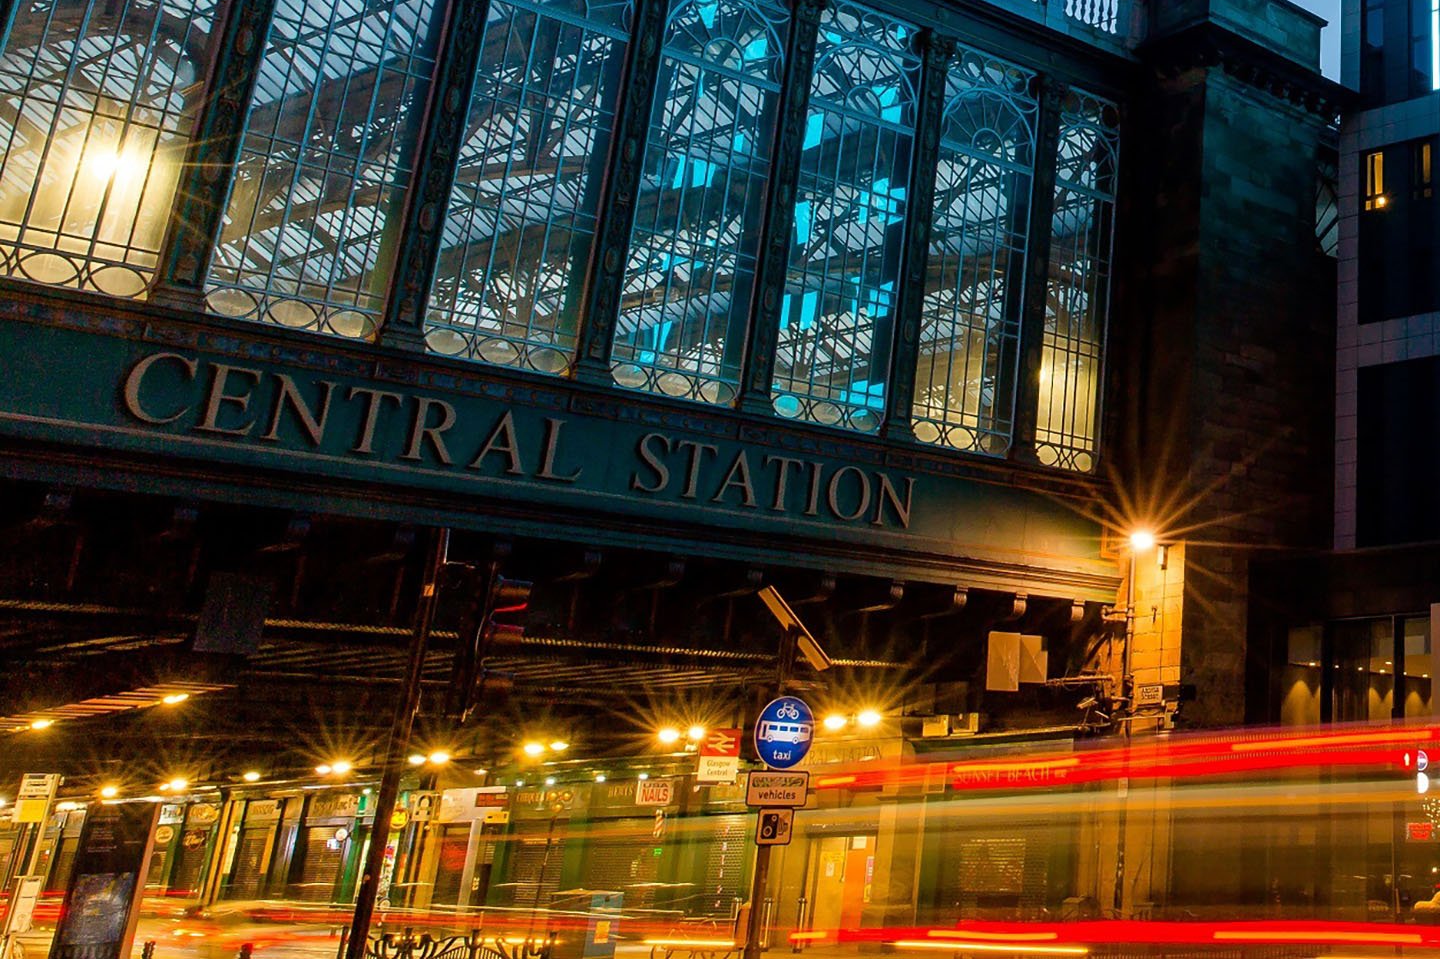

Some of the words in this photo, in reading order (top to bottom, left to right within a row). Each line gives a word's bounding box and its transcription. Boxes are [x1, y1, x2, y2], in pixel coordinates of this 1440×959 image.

[124, 352, 584, 482] CENTRAL
[631, 432, 917, 529] STATION
[772, 750, 792, 761] taxi
[706, 760, 731, 769] Glasgow
[706, 769, 728, 777] Central
[641, 788, 669, 802] NAILS
[758, 789, 796, 800] vehicles
